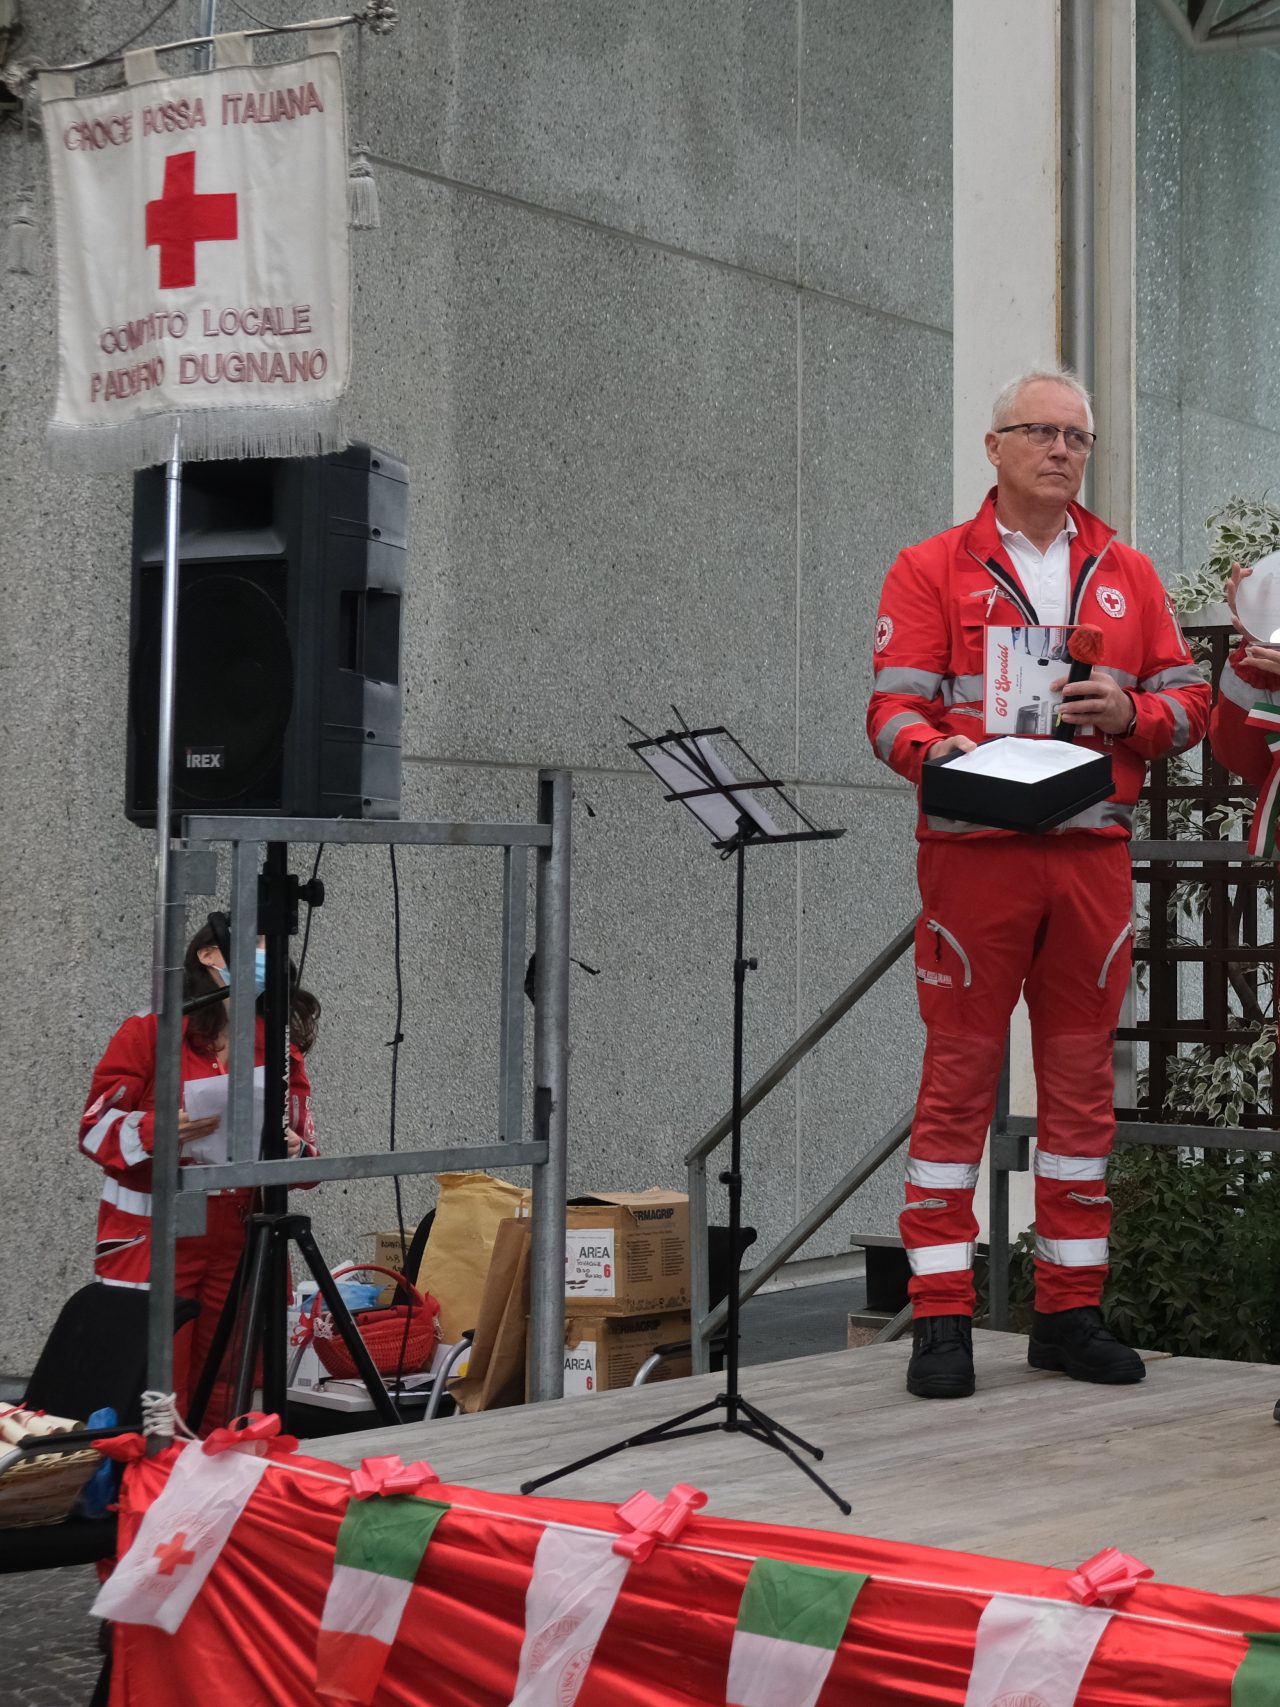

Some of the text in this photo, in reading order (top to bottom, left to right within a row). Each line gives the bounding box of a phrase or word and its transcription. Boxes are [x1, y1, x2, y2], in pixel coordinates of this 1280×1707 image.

[221, 82, 324, 125] ITALIANA
[203, 304, 312, 337] LOCALE
[178, 349, 328, 385] DUGNANO
[993, 643, 1012, 693] Special
[186, 753, 221, 768] IREX
[579, 1246, 610, 1259] AREA
[603, 1263, 611, 1278] 6
[564, 1358, 592, 1371] AREA
[586, 1376, 593, 1391] 6
